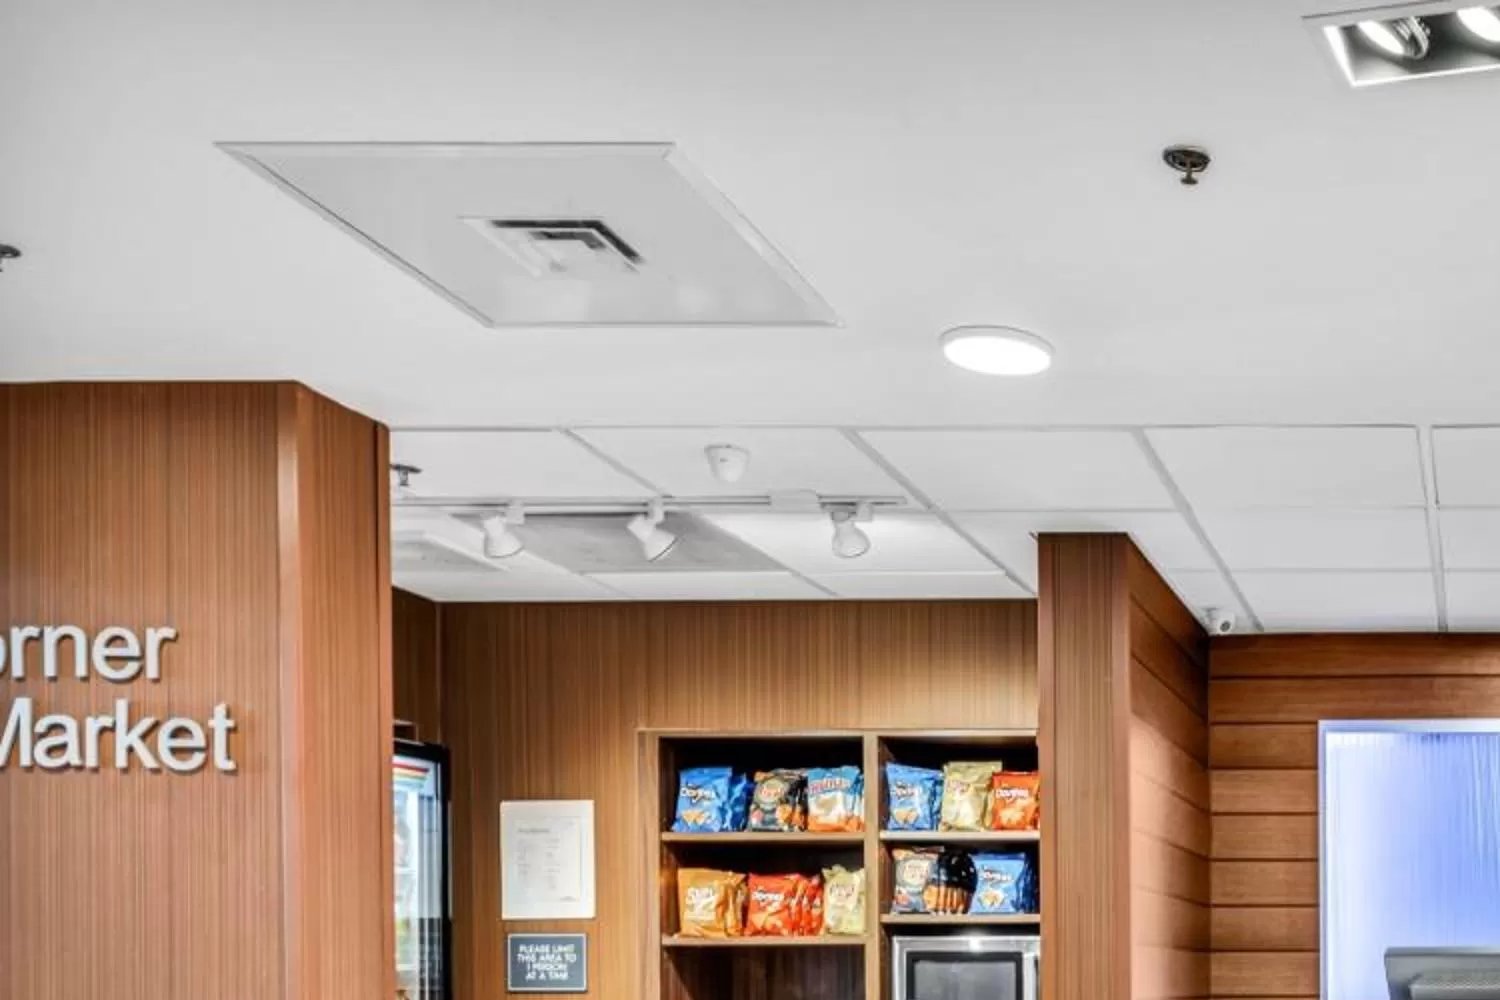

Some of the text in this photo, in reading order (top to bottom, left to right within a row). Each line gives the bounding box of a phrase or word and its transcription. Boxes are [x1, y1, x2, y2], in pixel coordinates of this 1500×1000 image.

[0, 625, 177, 680] rner
[519, 943, 550, 953] PLEASE
[517, 953, 537, 963] THIS
[564, 953, 577, 963] TO
